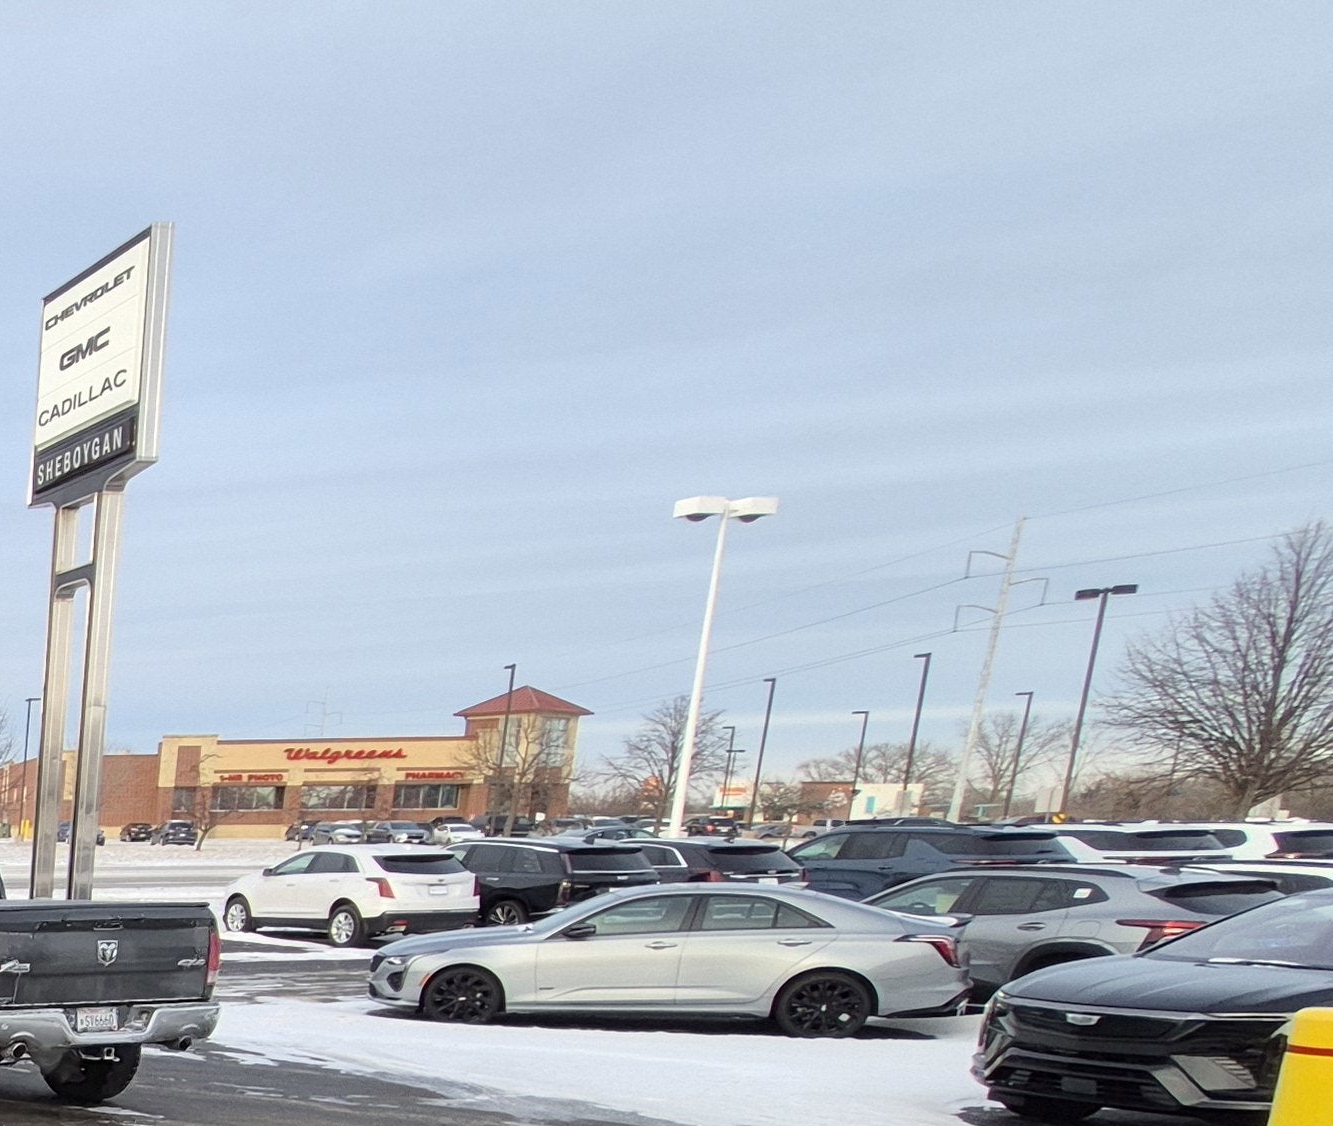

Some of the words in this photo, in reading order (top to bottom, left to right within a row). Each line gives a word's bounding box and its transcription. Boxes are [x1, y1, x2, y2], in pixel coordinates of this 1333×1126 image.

[44, 265, 135, 331] CHEVROLET
[59, 326, 111, 371] GMC
[37, 368, 128, 427] CADILLAC
[37, 426, 123, 485] SHEBOYGAN
[284, 747, 408, 764] Walgreens
